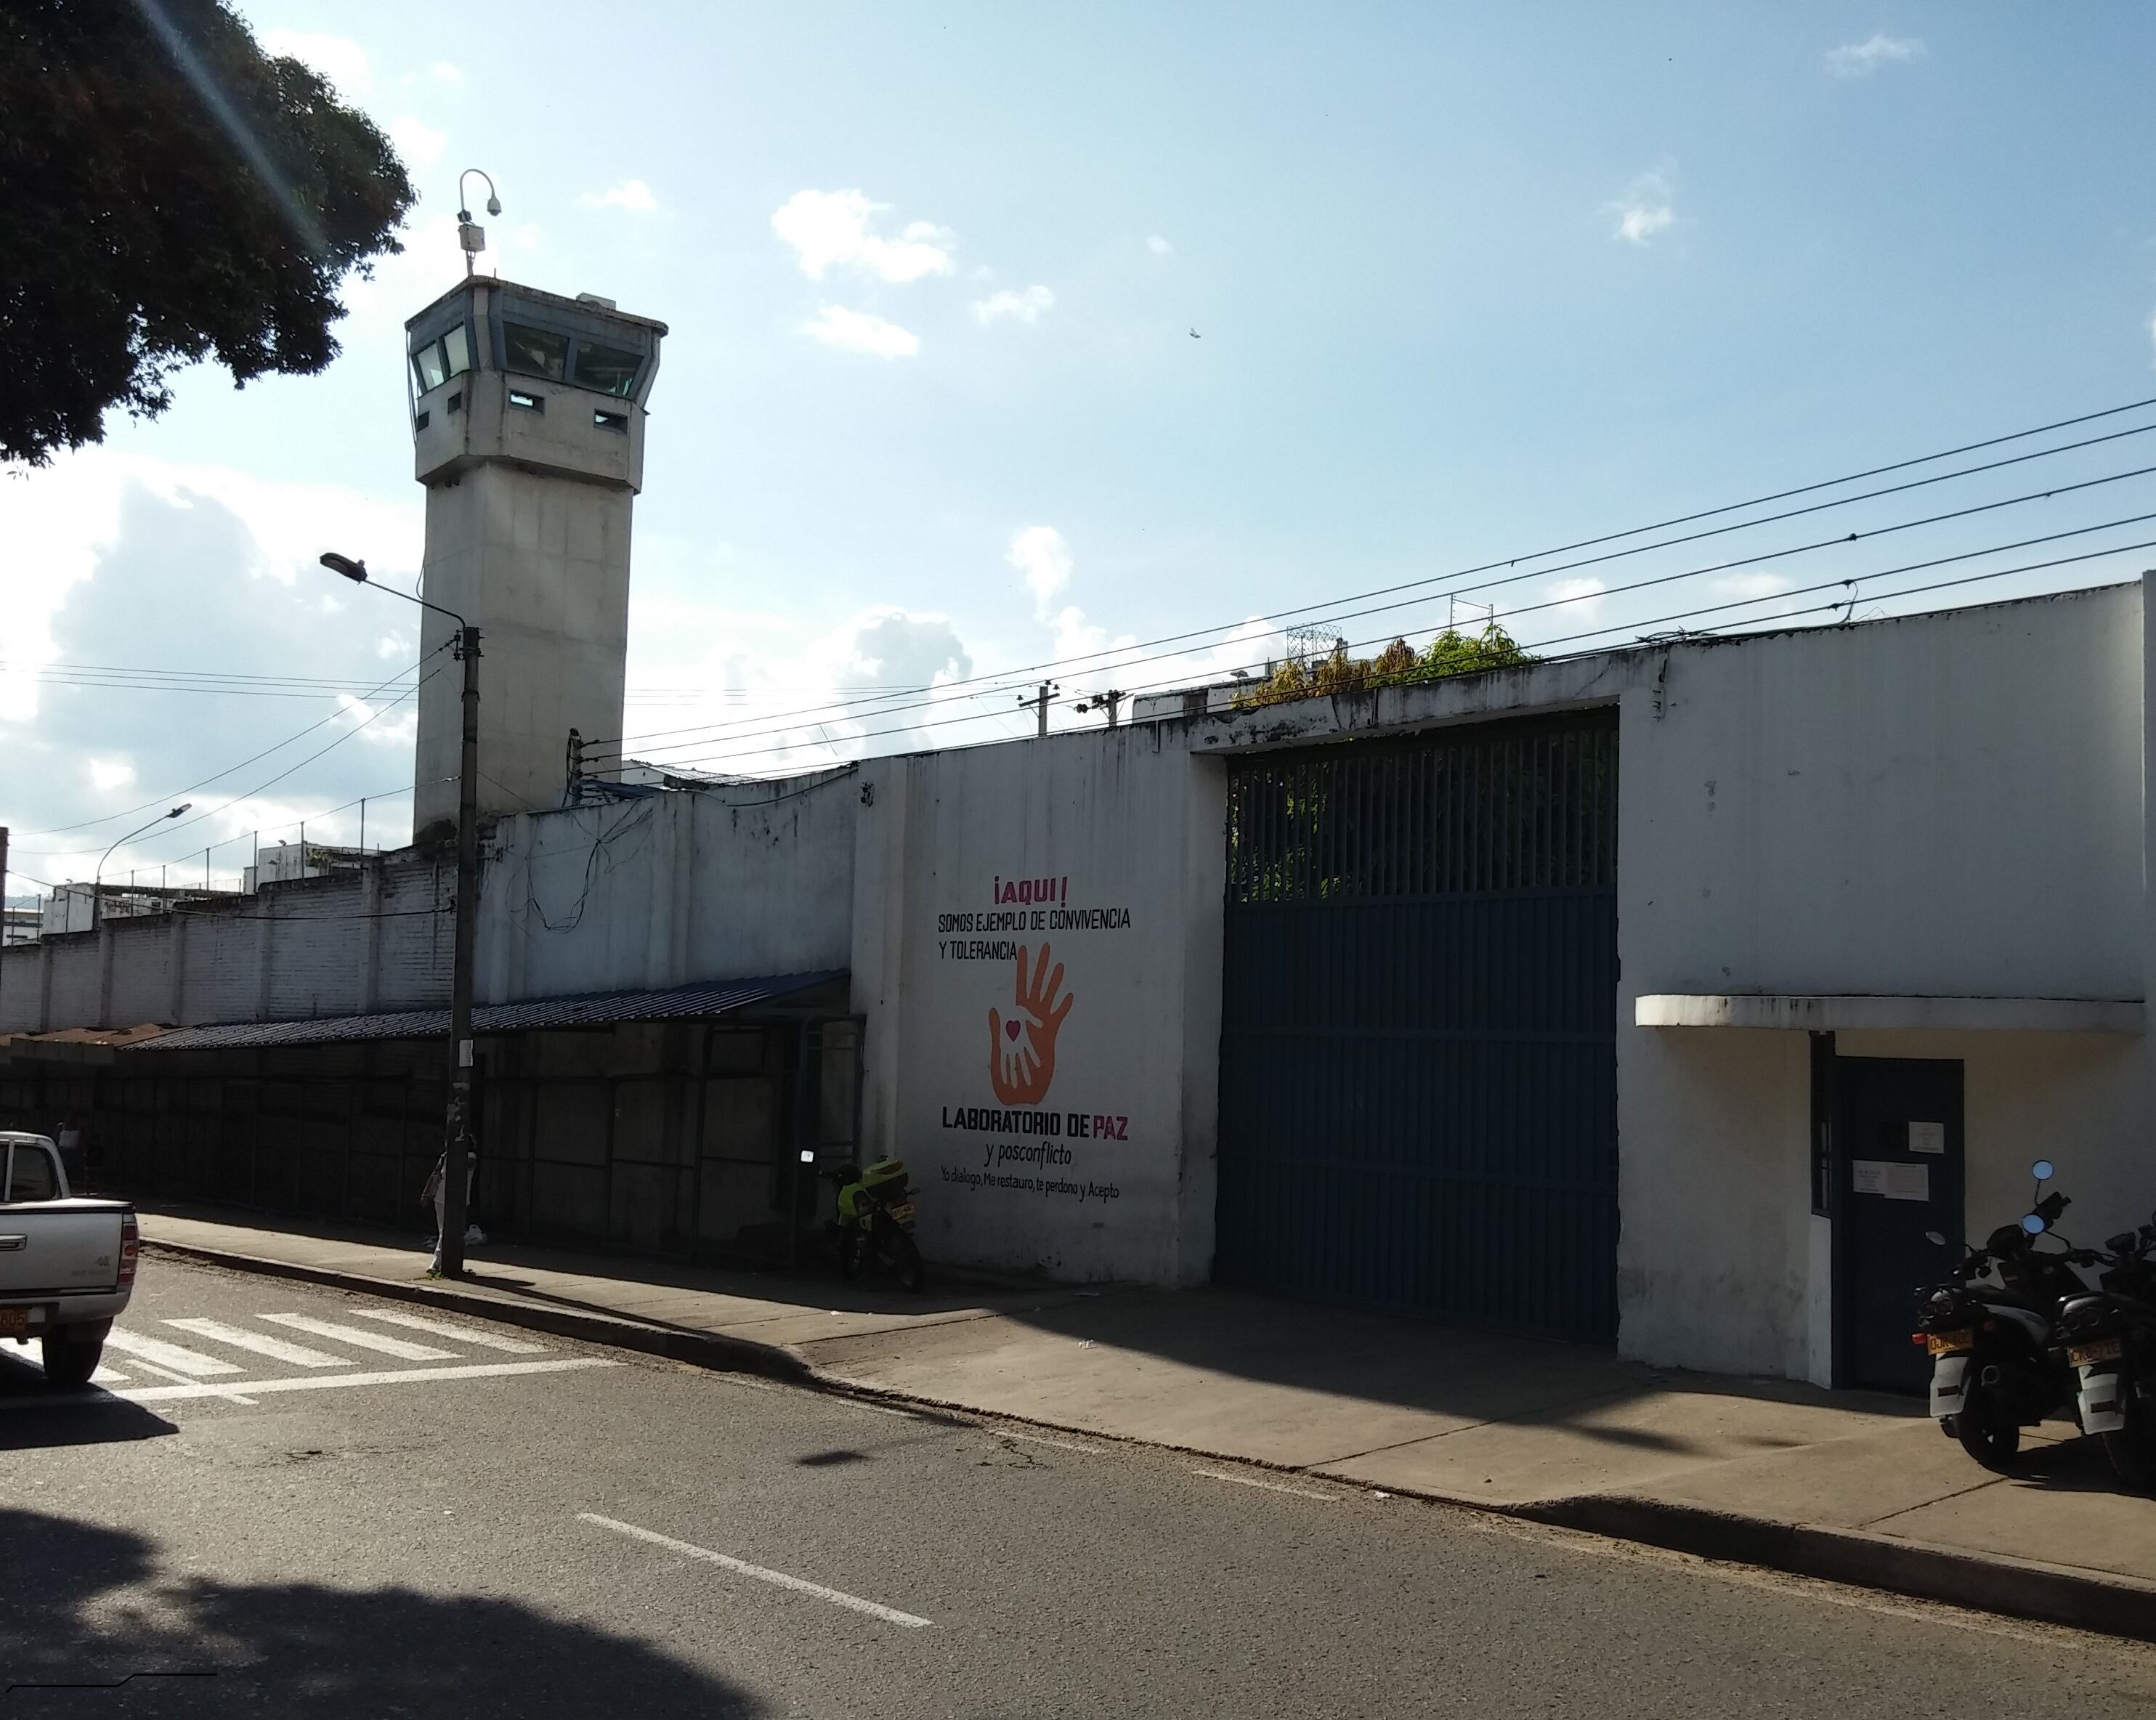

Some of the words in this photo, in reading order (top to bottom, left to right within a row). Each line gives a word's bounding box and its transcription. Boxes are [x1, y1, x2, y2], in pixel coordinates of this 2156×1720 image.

[938, 912, 973, 933] SOMOS
[976, 911, 1026, 932] EJEMPLO
[1030, 910, 1046, 930] DE
[1049, 907, 1131, 930] CONVIVENCIA
[939, 941, 947, 960] Y
[949, 941, 1018, 960] TOLERANCIA
[942, 1106, 1061, 1136] LABORATORIO
[1067, 1113, 1090, 1138] DE
[1093, 1115, 1129, 1141] PAZ
[984, 1143, 994, 1168] y
[997, 1140, 1072, 1170] posconflicto
[941, 1165, 950, 1182] Yo
[984, 1172, 996, 1187] Me
[997, 1173, 1035, 1193] restauro,
[1036, 1177, 1045, 1192] te
[1045, 1177, 1078, 1198] perdono
[1079, 1185, 1086, 1203] y
[1088, 1181, 1119, 1204] Acepto
